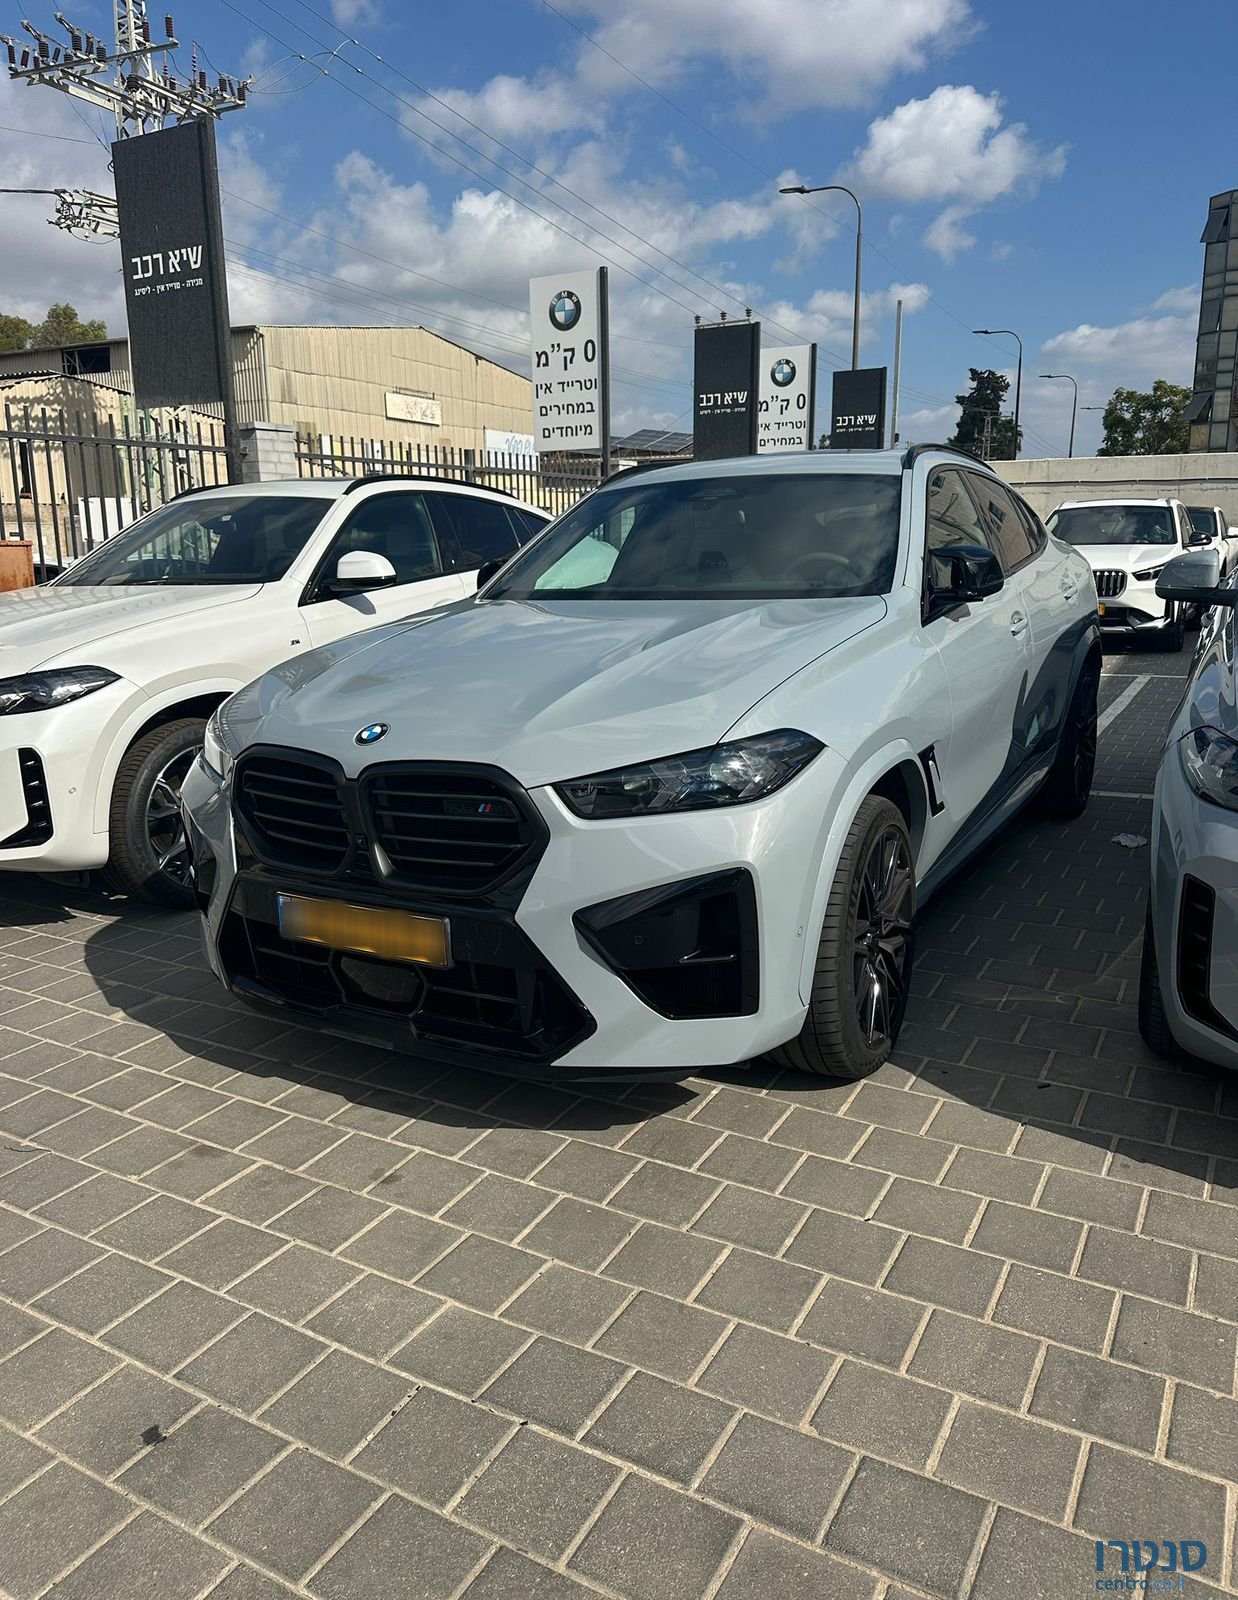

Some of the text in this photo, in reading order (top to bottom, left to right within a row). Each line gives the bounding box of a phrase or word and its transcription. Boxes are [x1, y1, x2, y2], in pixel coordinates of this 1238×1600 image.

[131, 245, 202, 280] שיא רכב
[583, 339, 597, 363] 0
[535, 378, 598, 399] וטרייד אין
[699, 391, 747, 407] שיא רכב
[796, 393, 806, 410] 0
[539, 401, 595, 417] במחירים
[774, 420, 806, 431] וטרייד
[836, 414, 876, 426] שיא רכב
[542, 424, 593, 438] מיוחדים
[759, 436, 803, 447] במחירים
